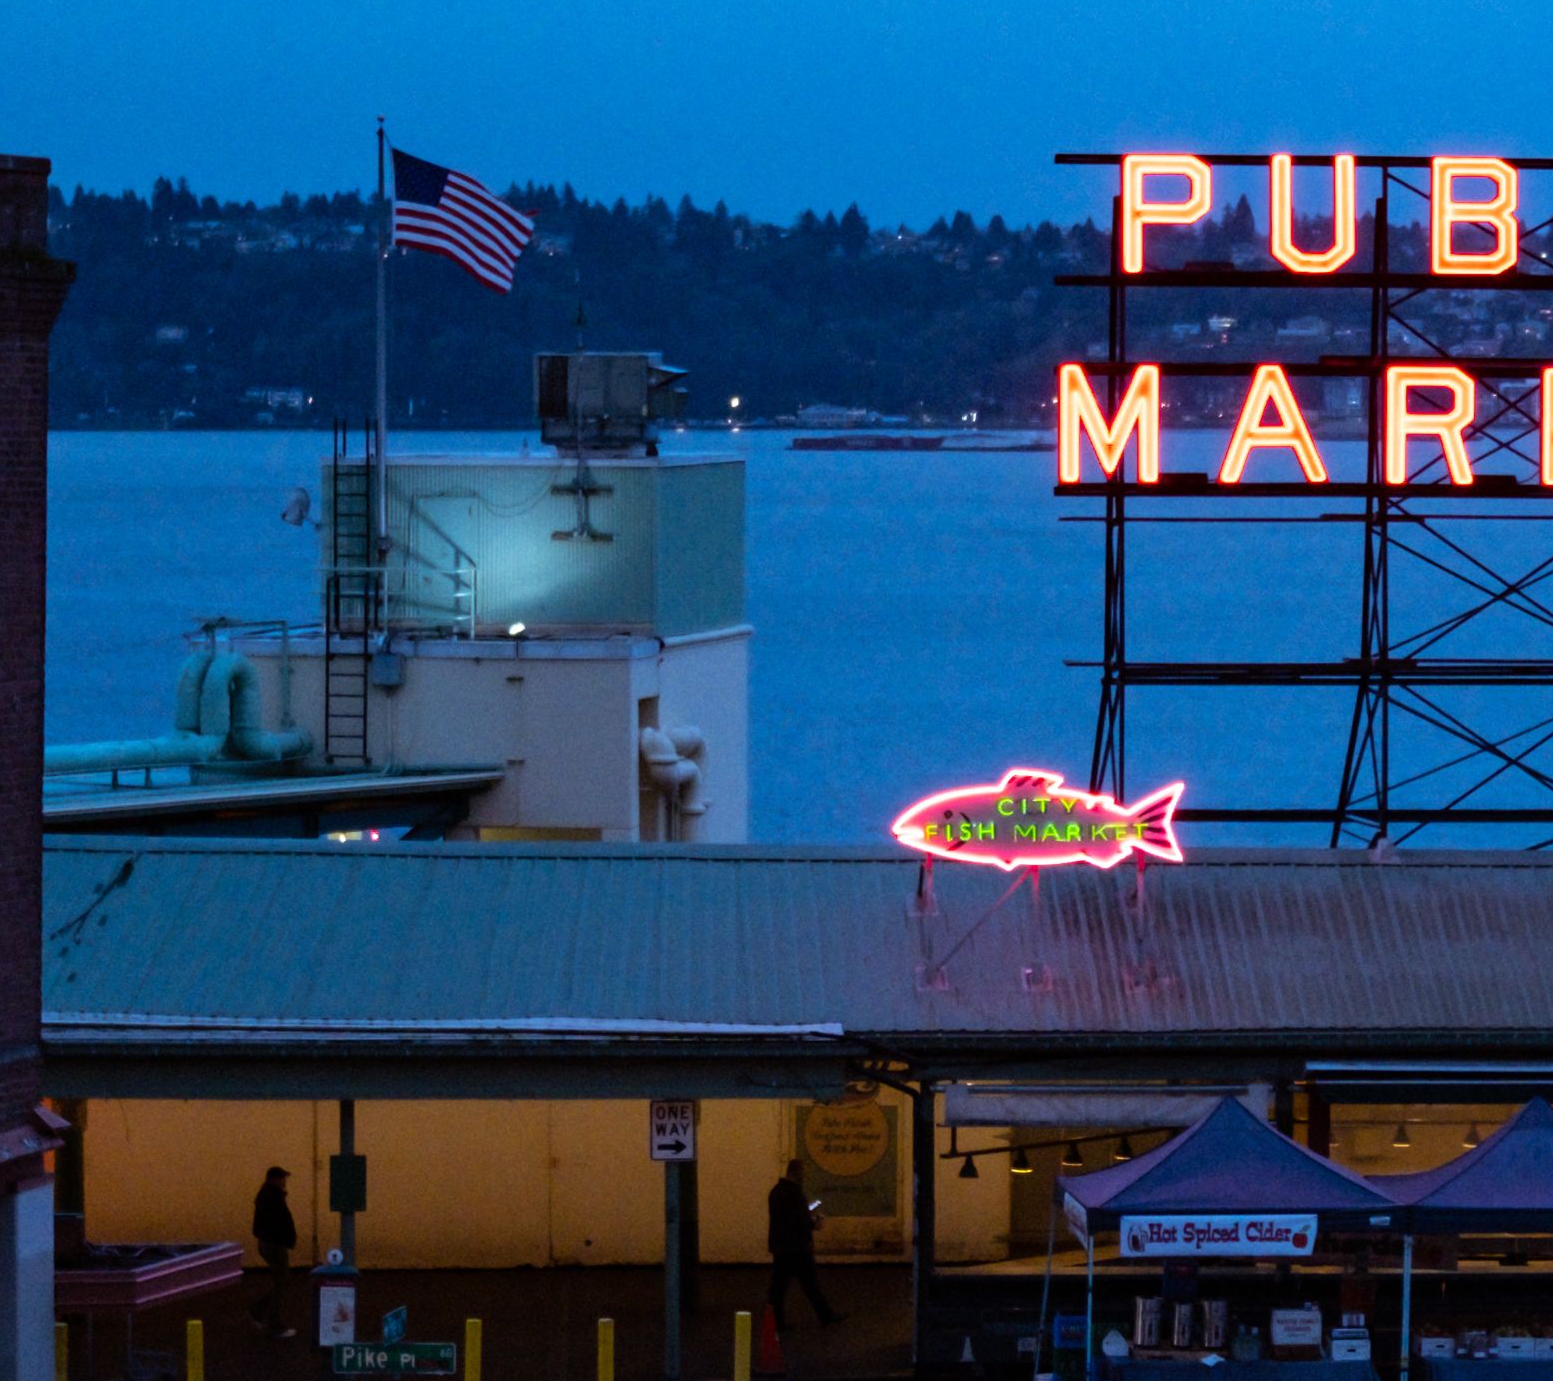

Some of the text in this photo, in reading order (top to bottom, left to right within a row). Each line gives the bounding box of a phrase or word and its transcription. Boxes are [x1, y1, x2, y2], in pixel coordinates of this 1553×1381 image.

[997, 798, 1078, 817] CITY
[924, 822, 1149, 842] FISH MARKET
[656, 1106, 689, 1120] ONE
[656, 1123, 690, 1136] WAY
[1148, 1222, 1292, 1249] Hot Spiced Cider
[342, 1346, 388, 1369] Pike
[400, 1353, 416, 1369] Pl
